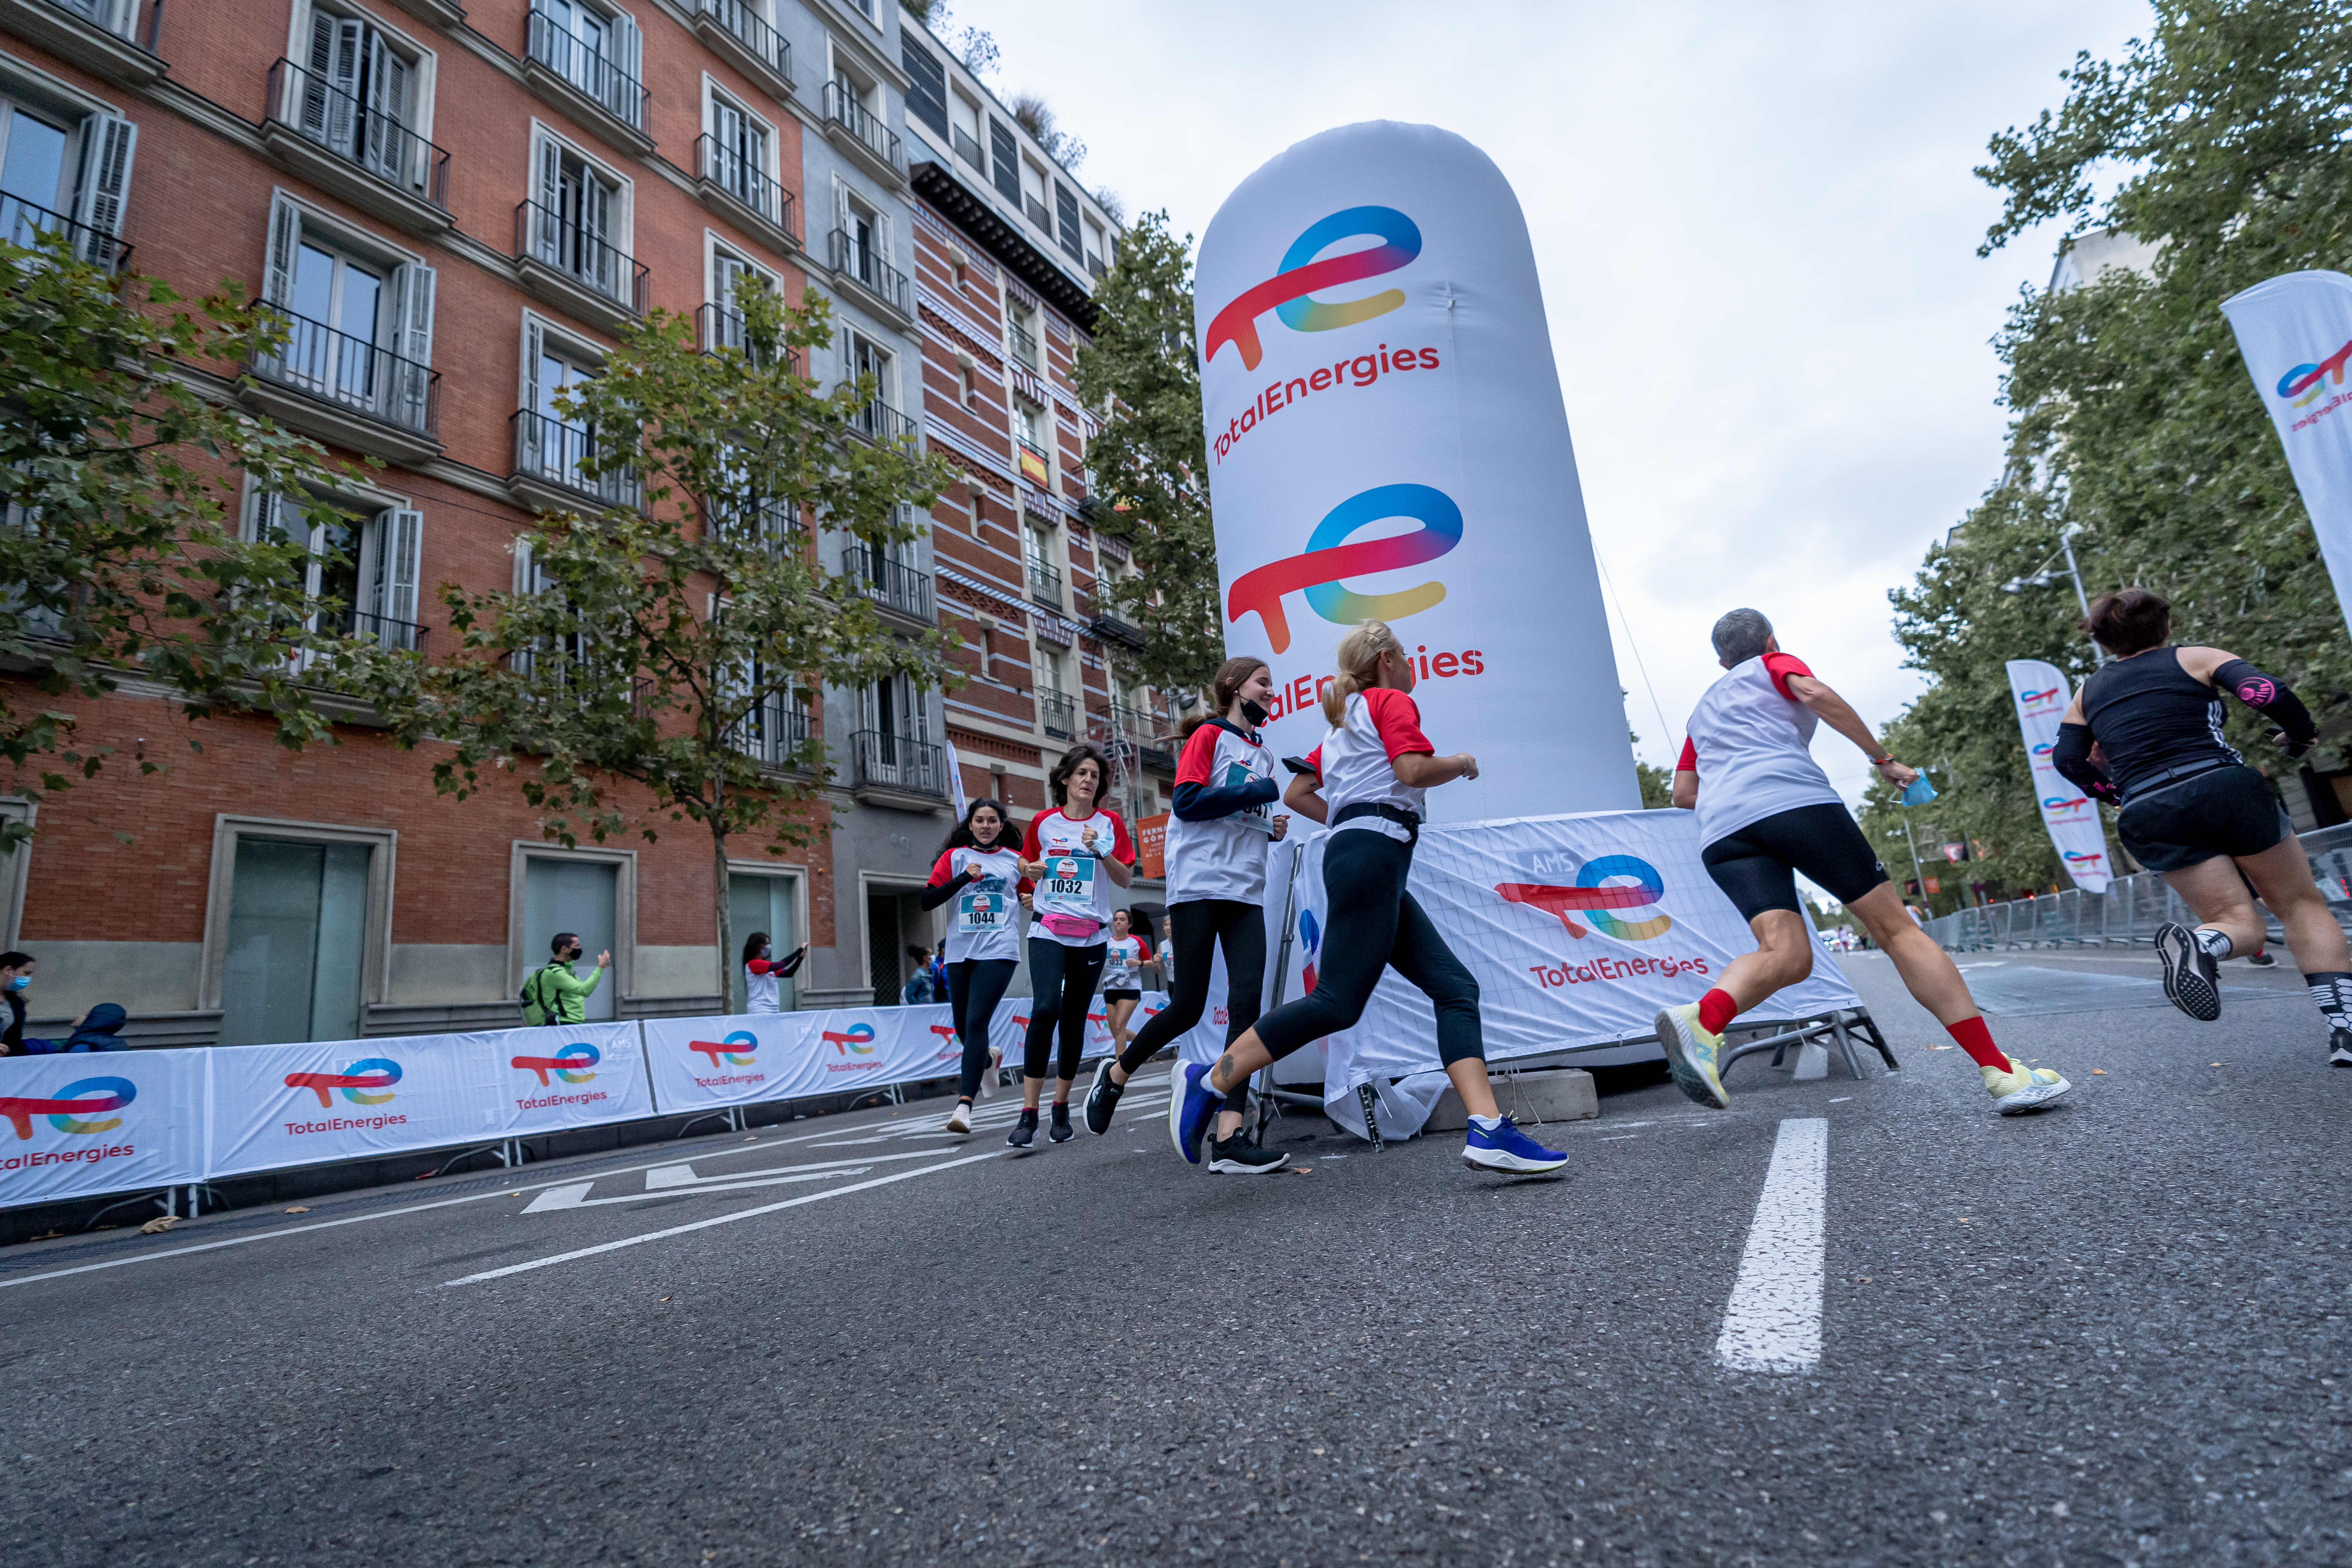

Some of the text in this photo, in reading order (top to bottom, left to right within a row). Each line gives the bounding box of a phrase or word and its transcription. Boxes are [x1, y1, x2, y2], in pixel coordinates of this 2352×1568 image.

[1213, 344, 1440, 466] TotalEnergies
[1532, 852, 1575, 874] AMS
[1050, 879, 1082, 894] 1032
[968, 912, 995, 924] 1044
[1530, 956, 1709, 989] TotalEnergies
[826, 1060, 884, 1073] TotalEnergies
[694, 1073, 765, 1087] TotalEnergies
[515, 1091, 607, 1110] TotalEnergies
[285, 1113, 407, 1135] TotalEnergies
